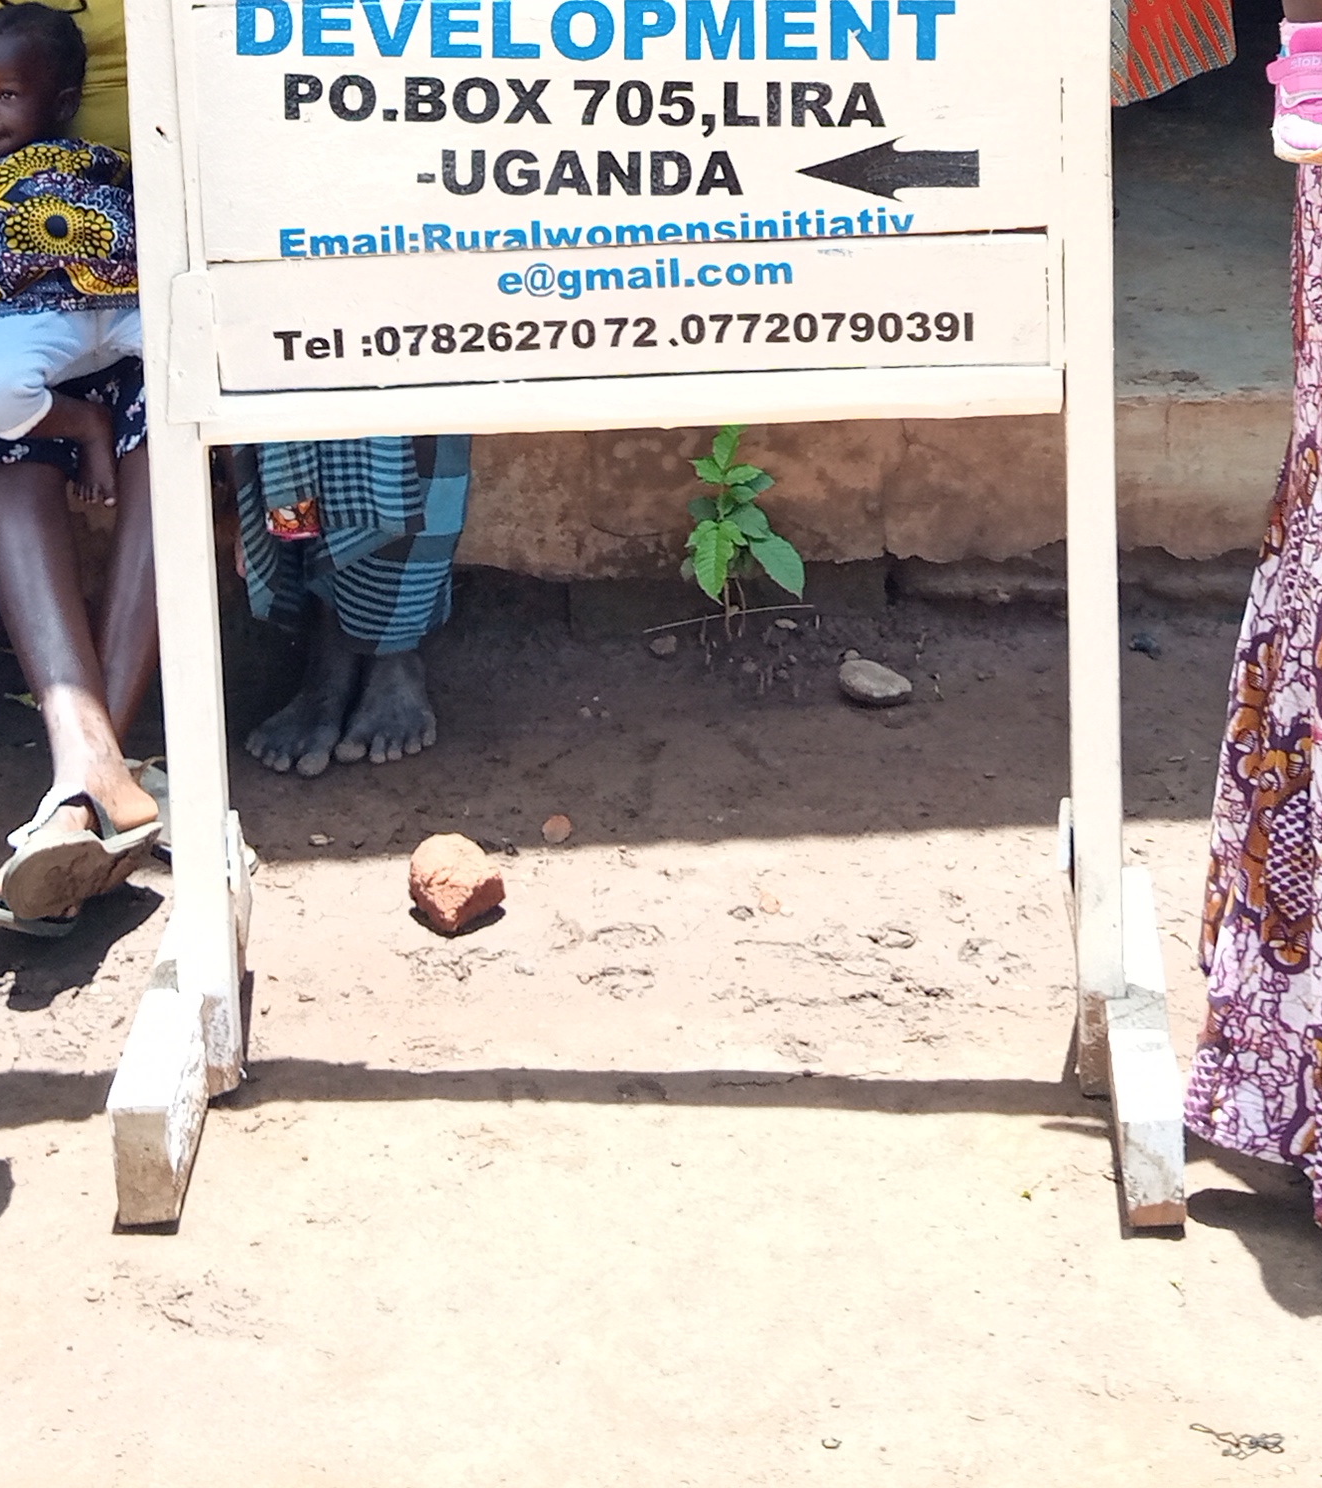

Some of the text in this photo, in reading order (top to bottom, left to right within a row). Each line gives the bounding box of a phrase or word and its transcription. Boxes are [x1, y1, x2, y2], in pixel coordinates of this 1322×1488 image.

[416, 149, 744, 196] -UGANDA
[497, 257, 793, 300] e@gmail.com
[273, 328, 344, 361] Tel
